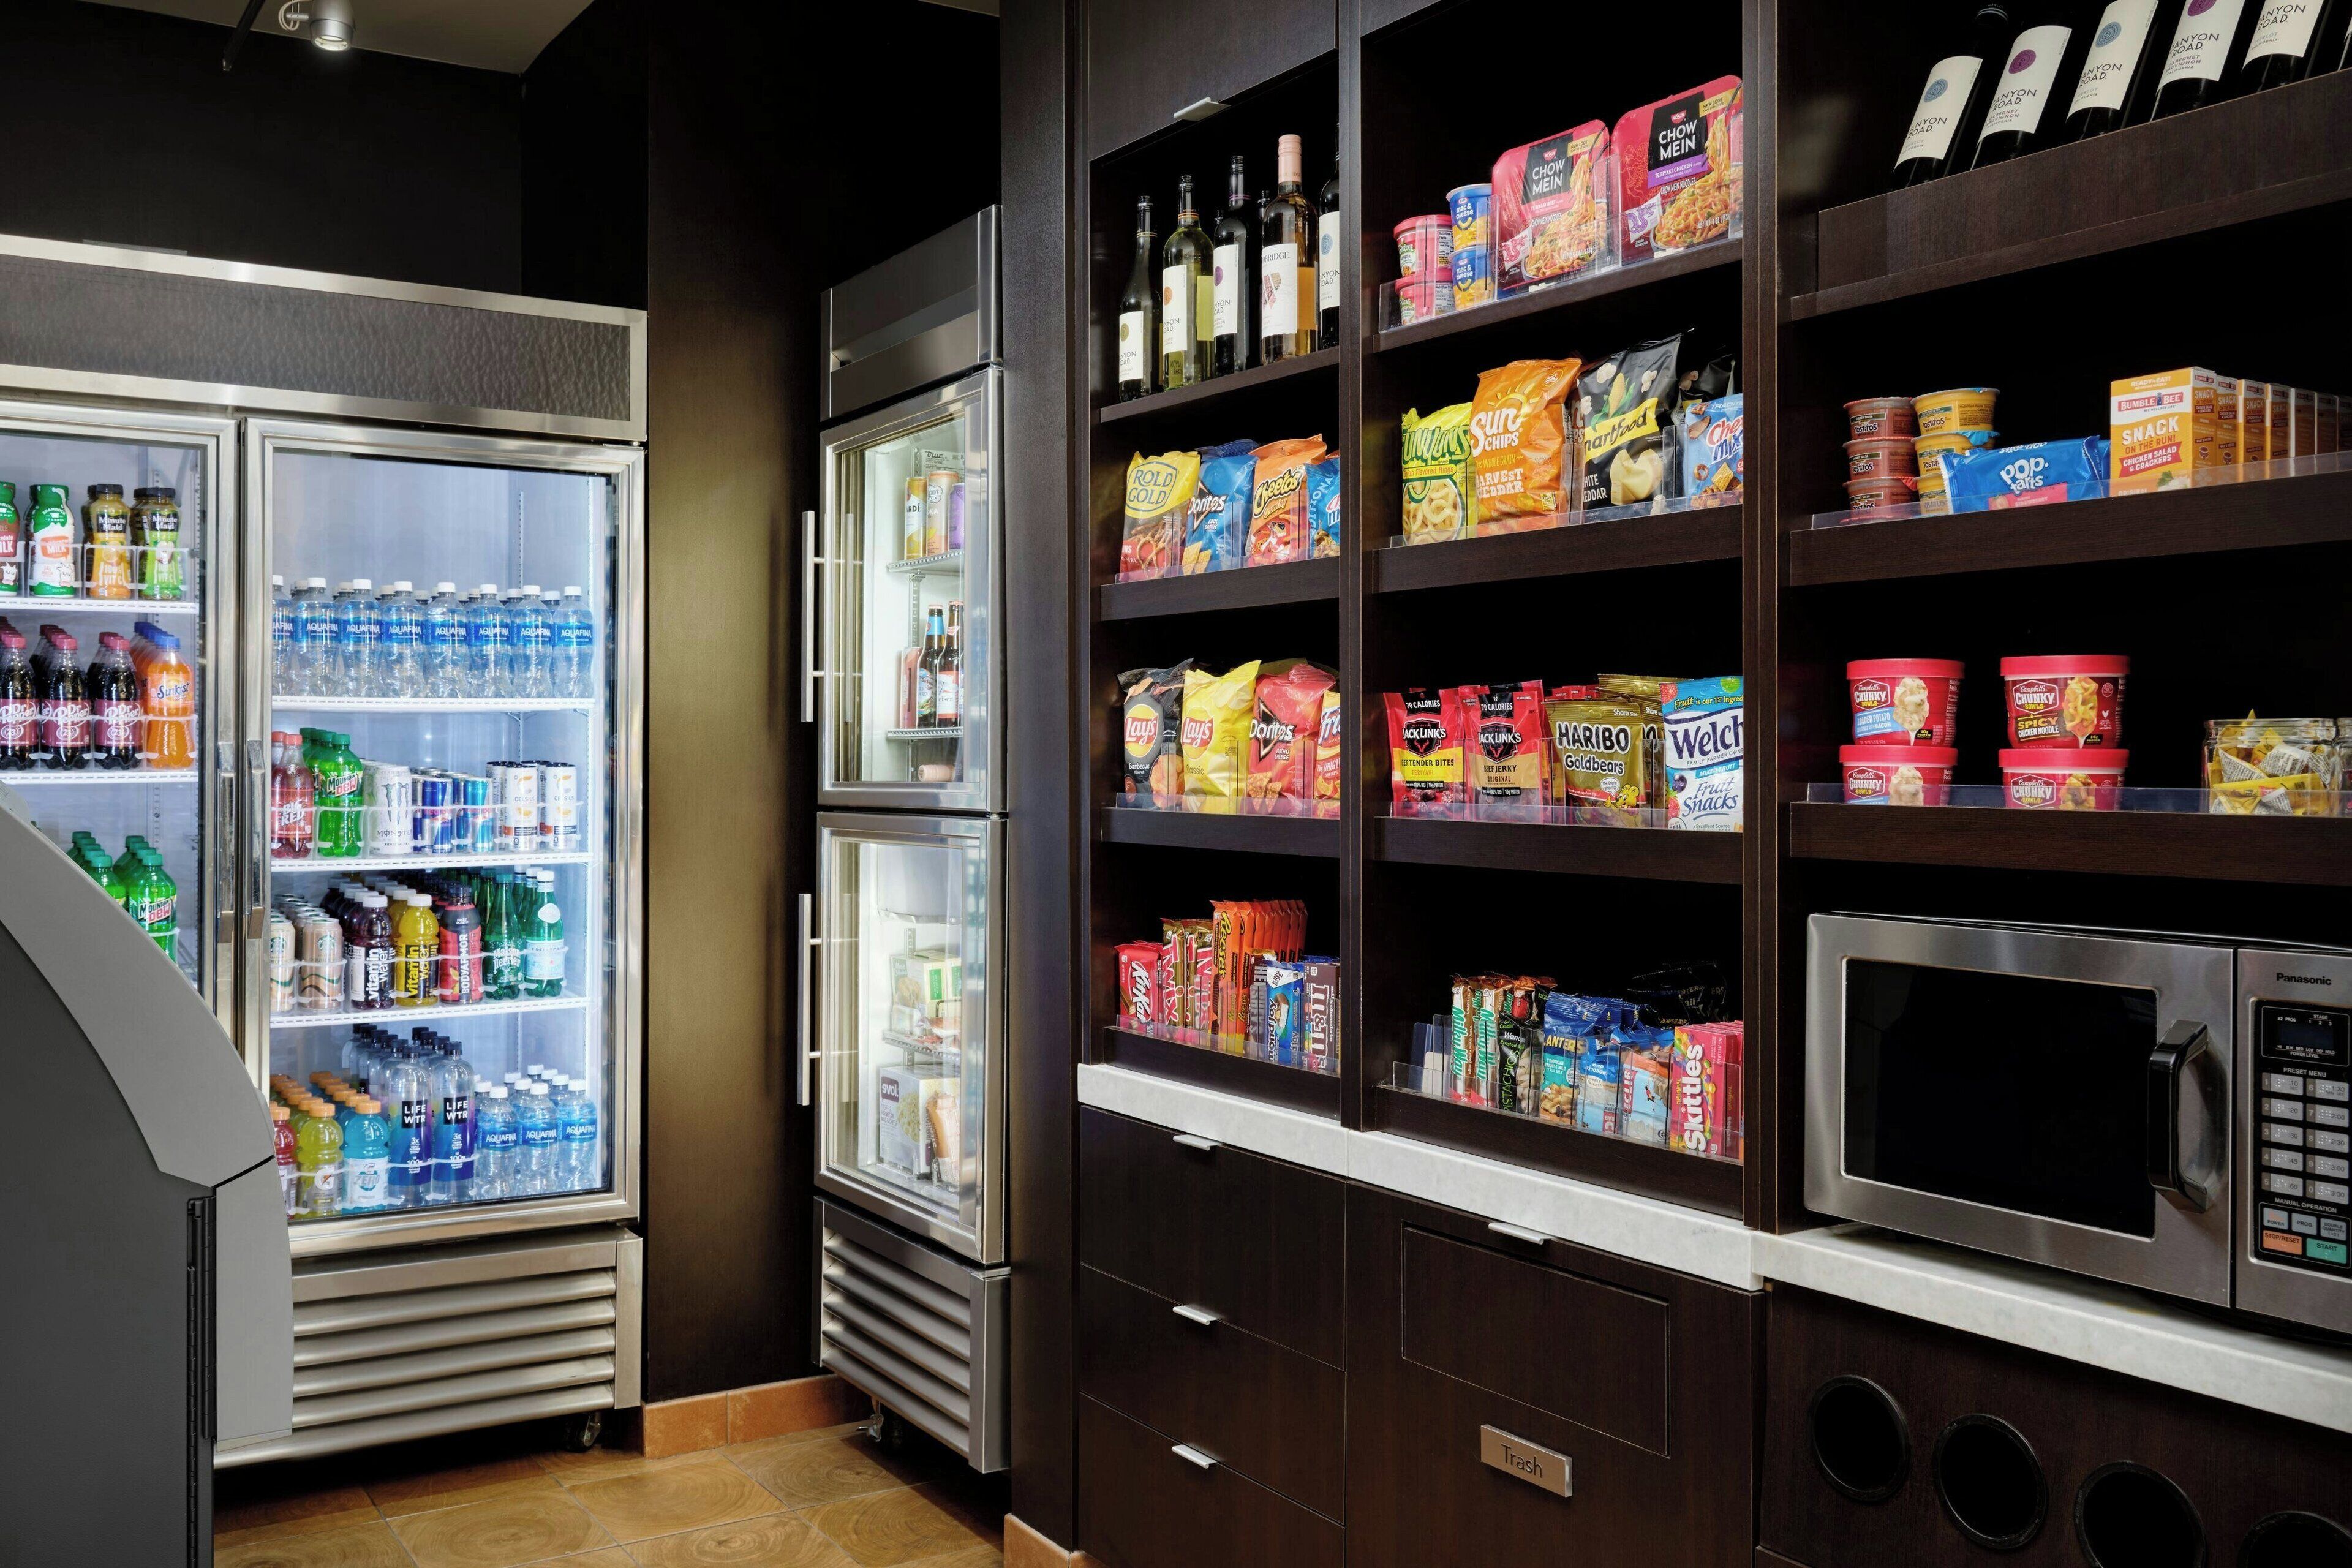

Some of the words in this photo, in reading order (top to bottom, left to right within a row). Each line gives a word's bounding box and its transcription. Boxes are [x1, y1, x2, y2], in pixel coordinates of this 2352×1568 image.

[2256, 14, 2288, 31] ROAD
[2171, 42, 2203, 58] ROAD
[1992, 97, 2021, 111] ROAD
[1659, 120, 1697, 144] CHOW
[1660, 135, 1695, 160] MEIN
[1532, 159, 1566, 180] CHOW
[1655, 168, 1673, 178] TERIYAKI
[1674, 162, 1692, 173] CHICKEN
[1532, 173, 1562, 195] MEIN
[2131, 378, 2152, 387] READY
[2195, 389, 2214, 399] SNACK
[2120, 398, 2155, 410] BUMBLE
[2163, 394, 2180, 404] BEE
[1469, 407, 1521, 458] Sun
[2122, 417, 2179, 445] SNACK
[1483, 431, 1520, 452] CHIPS
[2138, 440, 2154, 451] THE
[2156, 435, 2176, 446] RUN!
[1483, 457, 1499, 468] WHOLE
[1500, 454, 1516, 466] GRAIN
[2124, 453, 2152, 466] CHICKEN
[2154, 446, 2177, 457] SALAD
[2135, 455, 2171, 471] CRACKERS
[1416, 467, 1437, 475] Flavored
[1438, 466, 1454, 474] Rings
[1133, 469, 1174, 488] ROLD
[2010, 475, 2043, 495] tarts
[1128, 488, 1167, 505] GOLD
[1254, 469, 1304, 516] Cheetos
[1187, 496, 1227, 515] Doritos
[99, 516, 126, 525] Minute
[152, 515, 178, 524] Minute
[47, 545, 67, 554] MILK
[306, 622, 339, 632] AQUAFINA
[346, 624, 380, 635] AQUAFINA
[388, 625, 422, 635] AQUAFINA
[435, 626, 467, 636] AQUAFINA
[478, 627, 509, 636] AQUAFINA
[521, 627, 551, 636] AQUAFINA
[560, 628, 592, 638] AQUAFINA
[157, 682, 190, 700] Sunkist
[1854, 691, 1887, 703] CHUNKY
[1675, 698, 1694, 710] Fruit
[2015, 693, 2055, 705] CHUNKY
[12, 704, 26, 714] Dr
[55, 707, 89, 725] Pepper
[69, 704, 81, 714] Dr
[105, 707, 138, 725] Pepper
[119, 704, 132, 714] Dr
[1857, 714, 1873, 726] LOADED
[1873, 712, 1891, 723] POTATO
[2018, 716, 2058, 729] SPICY
[1126, 717, 1158, 745] Lay's
[1183, 717, 1212, 748] Lay's
[1250, 719, 1296, 741] Doritos
[1403, 729, 1420, 739] JACK
[1420, 728, 1446, 739] LINK'S
[1556, 722, 1630, 753] HARIBO
[2018, 726, 2038, 738] CHICKEN
[2038, 725, 2059, 735] NOODLE
[1479, 733, 1495, 743] JACK
[1495, 732, 1521, 744] LINK'S
[1565, 754, 1624, 775] Goldbears
[1706, 752, 1728, 762] FARMER
[1186, 764, 1204, 775] Classic
[1699, 767, 1718, 777] MIXED
[1719, 764, 1736, 773] FRUIT
[1695, 777, 1736, 799] Fruit
[1849, 778, 1882, 790] CHUNKY
[2013, 786, 2052, 799] CHUNKY
[1681, 792, 1738, 818] Snacks
[281, 810, 304, 826] RED
[1218, 911, 1232, 979] Reese's
[379, 949, 388, 982] water
[420, 947, 429, 980] water
[460, 933, 469, 994] BODYARMOR
[494, 956, 521, 974] Perrier
[367, 948, 381, 999] vitamin
[406, 946, 419, 997] vitamin
[2276, 972, 2332, 986] Panasonic
[1131, 962, 1152, 1023] KitKat
[1504, 993, 1513, 1013] Way
[1501, 1039, 1516, 1048] Roasted
[446, 1100, 468, 1110] LIFE
[1682, 1044, 1707, 1152] Skittles
[404, 1104, 426, 1114] LIFE
[446, 1110, 468, 1120] WTR
[404, 1114, 426, 1124] WTR
[486, 1133, 517, 1143] AQUAFINA
[526, 1129, 556, 1140] AQUAFINA
[566, 1125, 595, 1136] AQUAFINA
[2275, 1197, 2301, 1207] MANUAL
[2301, 1202, 2337, 1213] OPERATION
[2264, 1232, 2300, 1244] STOP/RESET
[2316, 1243, 2338, 1251] START
[1501, 1443, 1543, 1478] Trash
